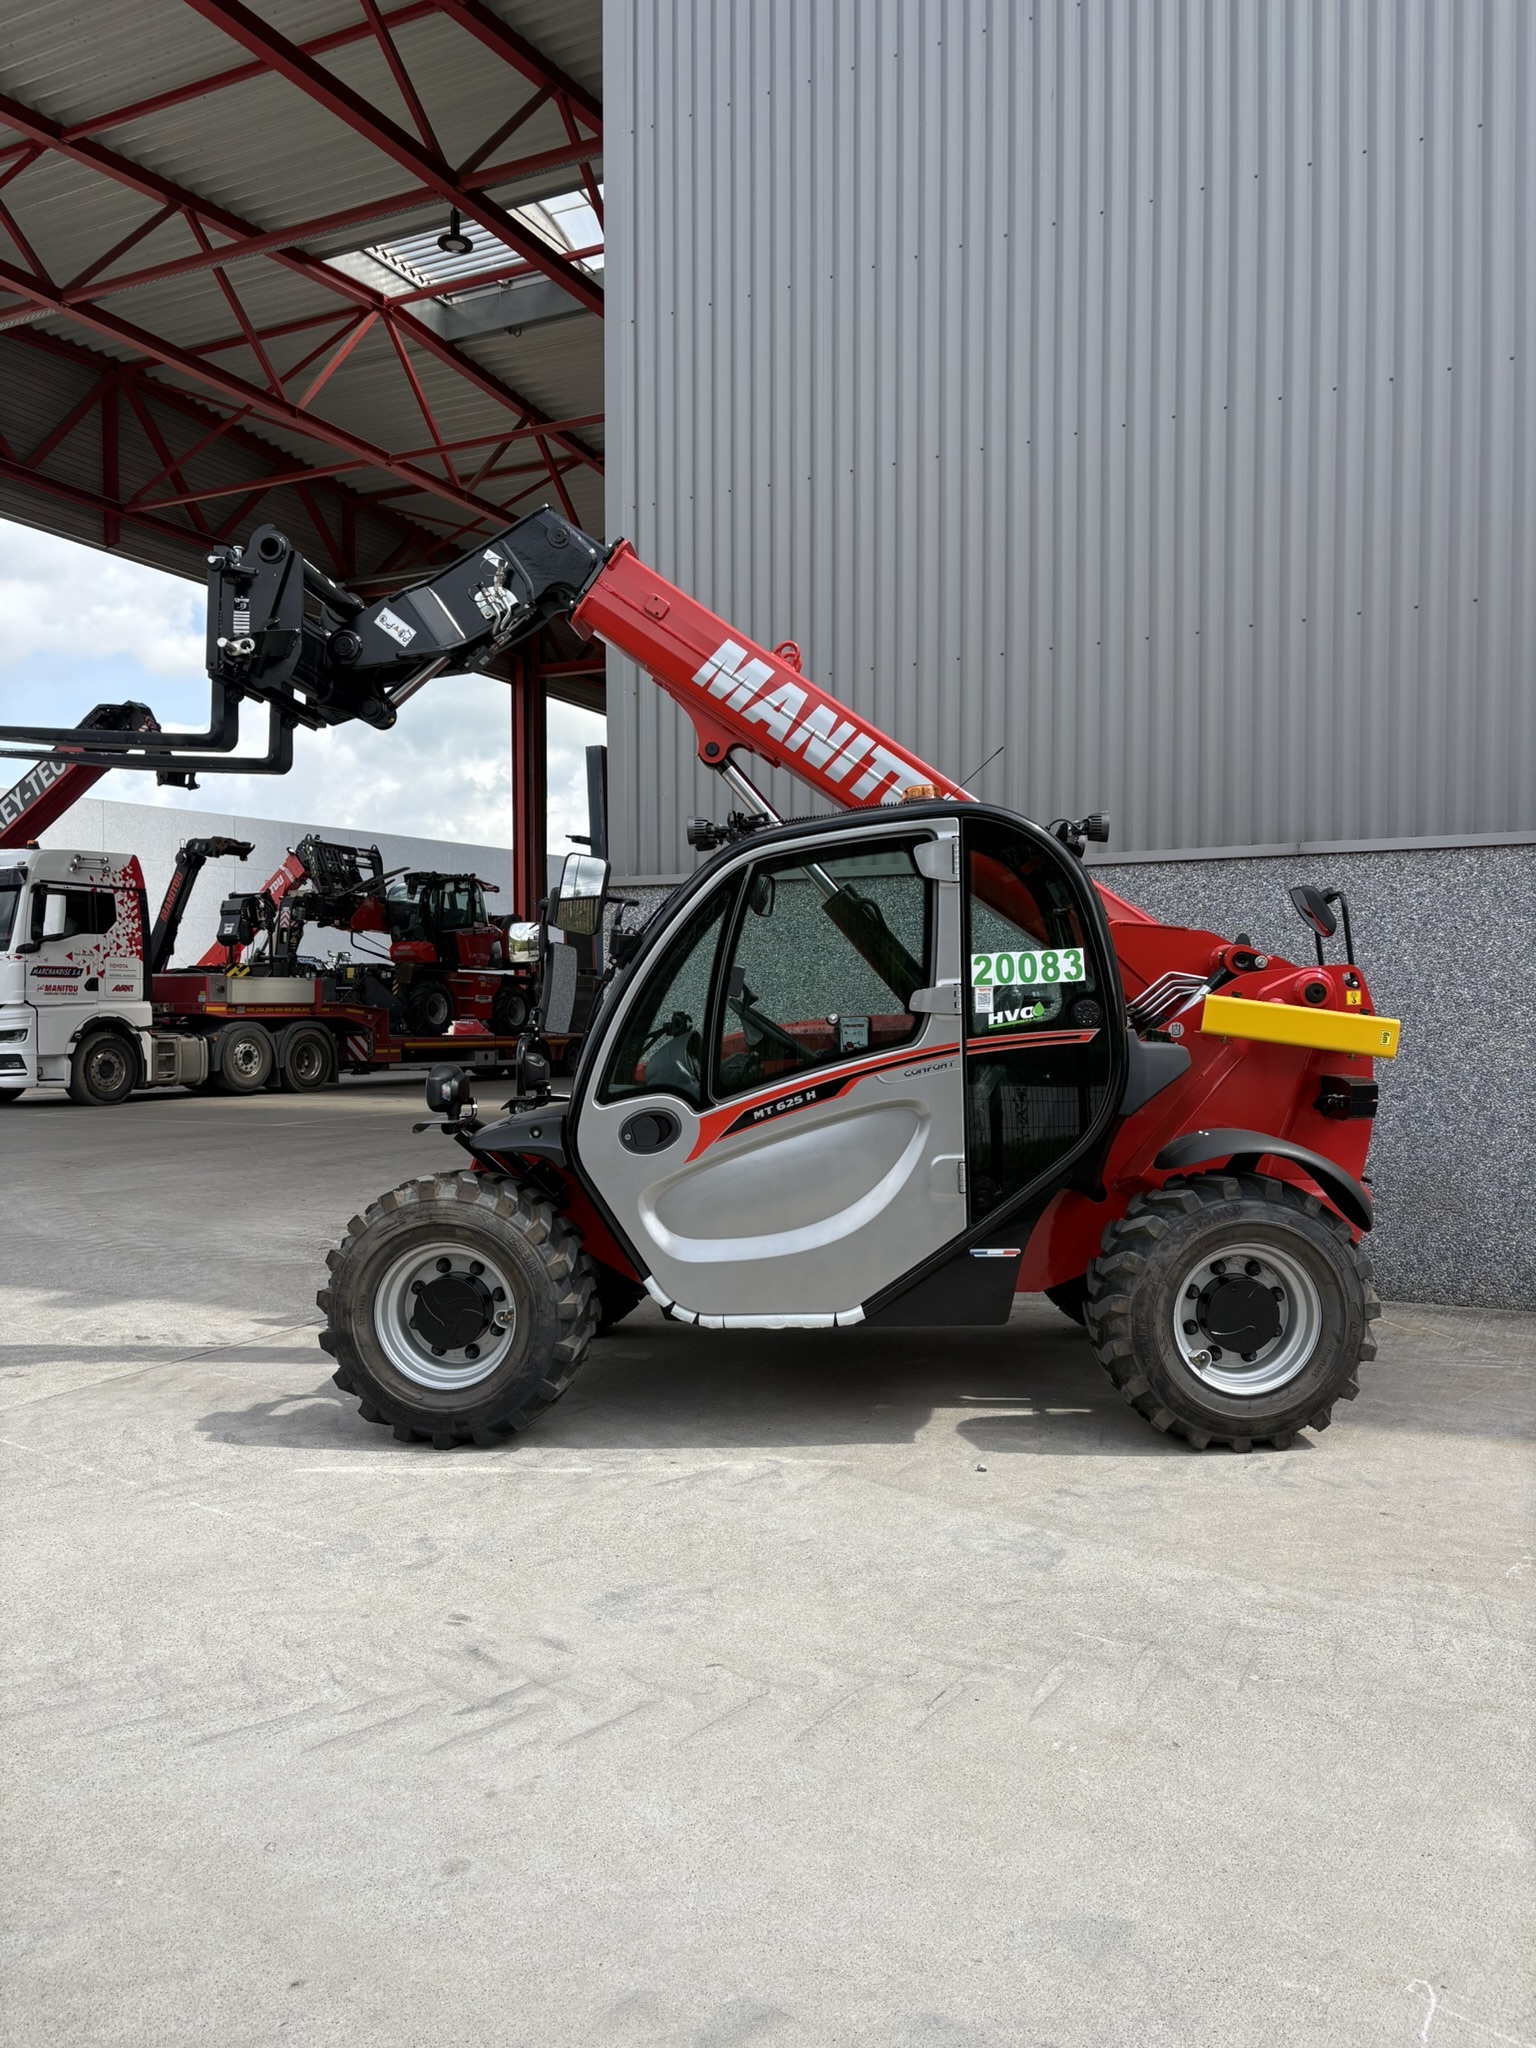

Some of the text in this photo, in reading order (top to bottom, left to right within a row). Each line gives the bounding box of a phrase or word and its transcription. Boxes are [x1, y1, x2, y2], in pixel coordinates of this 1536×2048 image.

[690, 638, 957, 805] MANIT
[159, 870, 184, 923] MANITOU
[32, 967, 71, 976] MARCHANDISE
[973, 949, 1083, 986] 20083
[44, 984, 78, 992] MANITOU
[753, 1090, 817, 1120] MT 625 H
